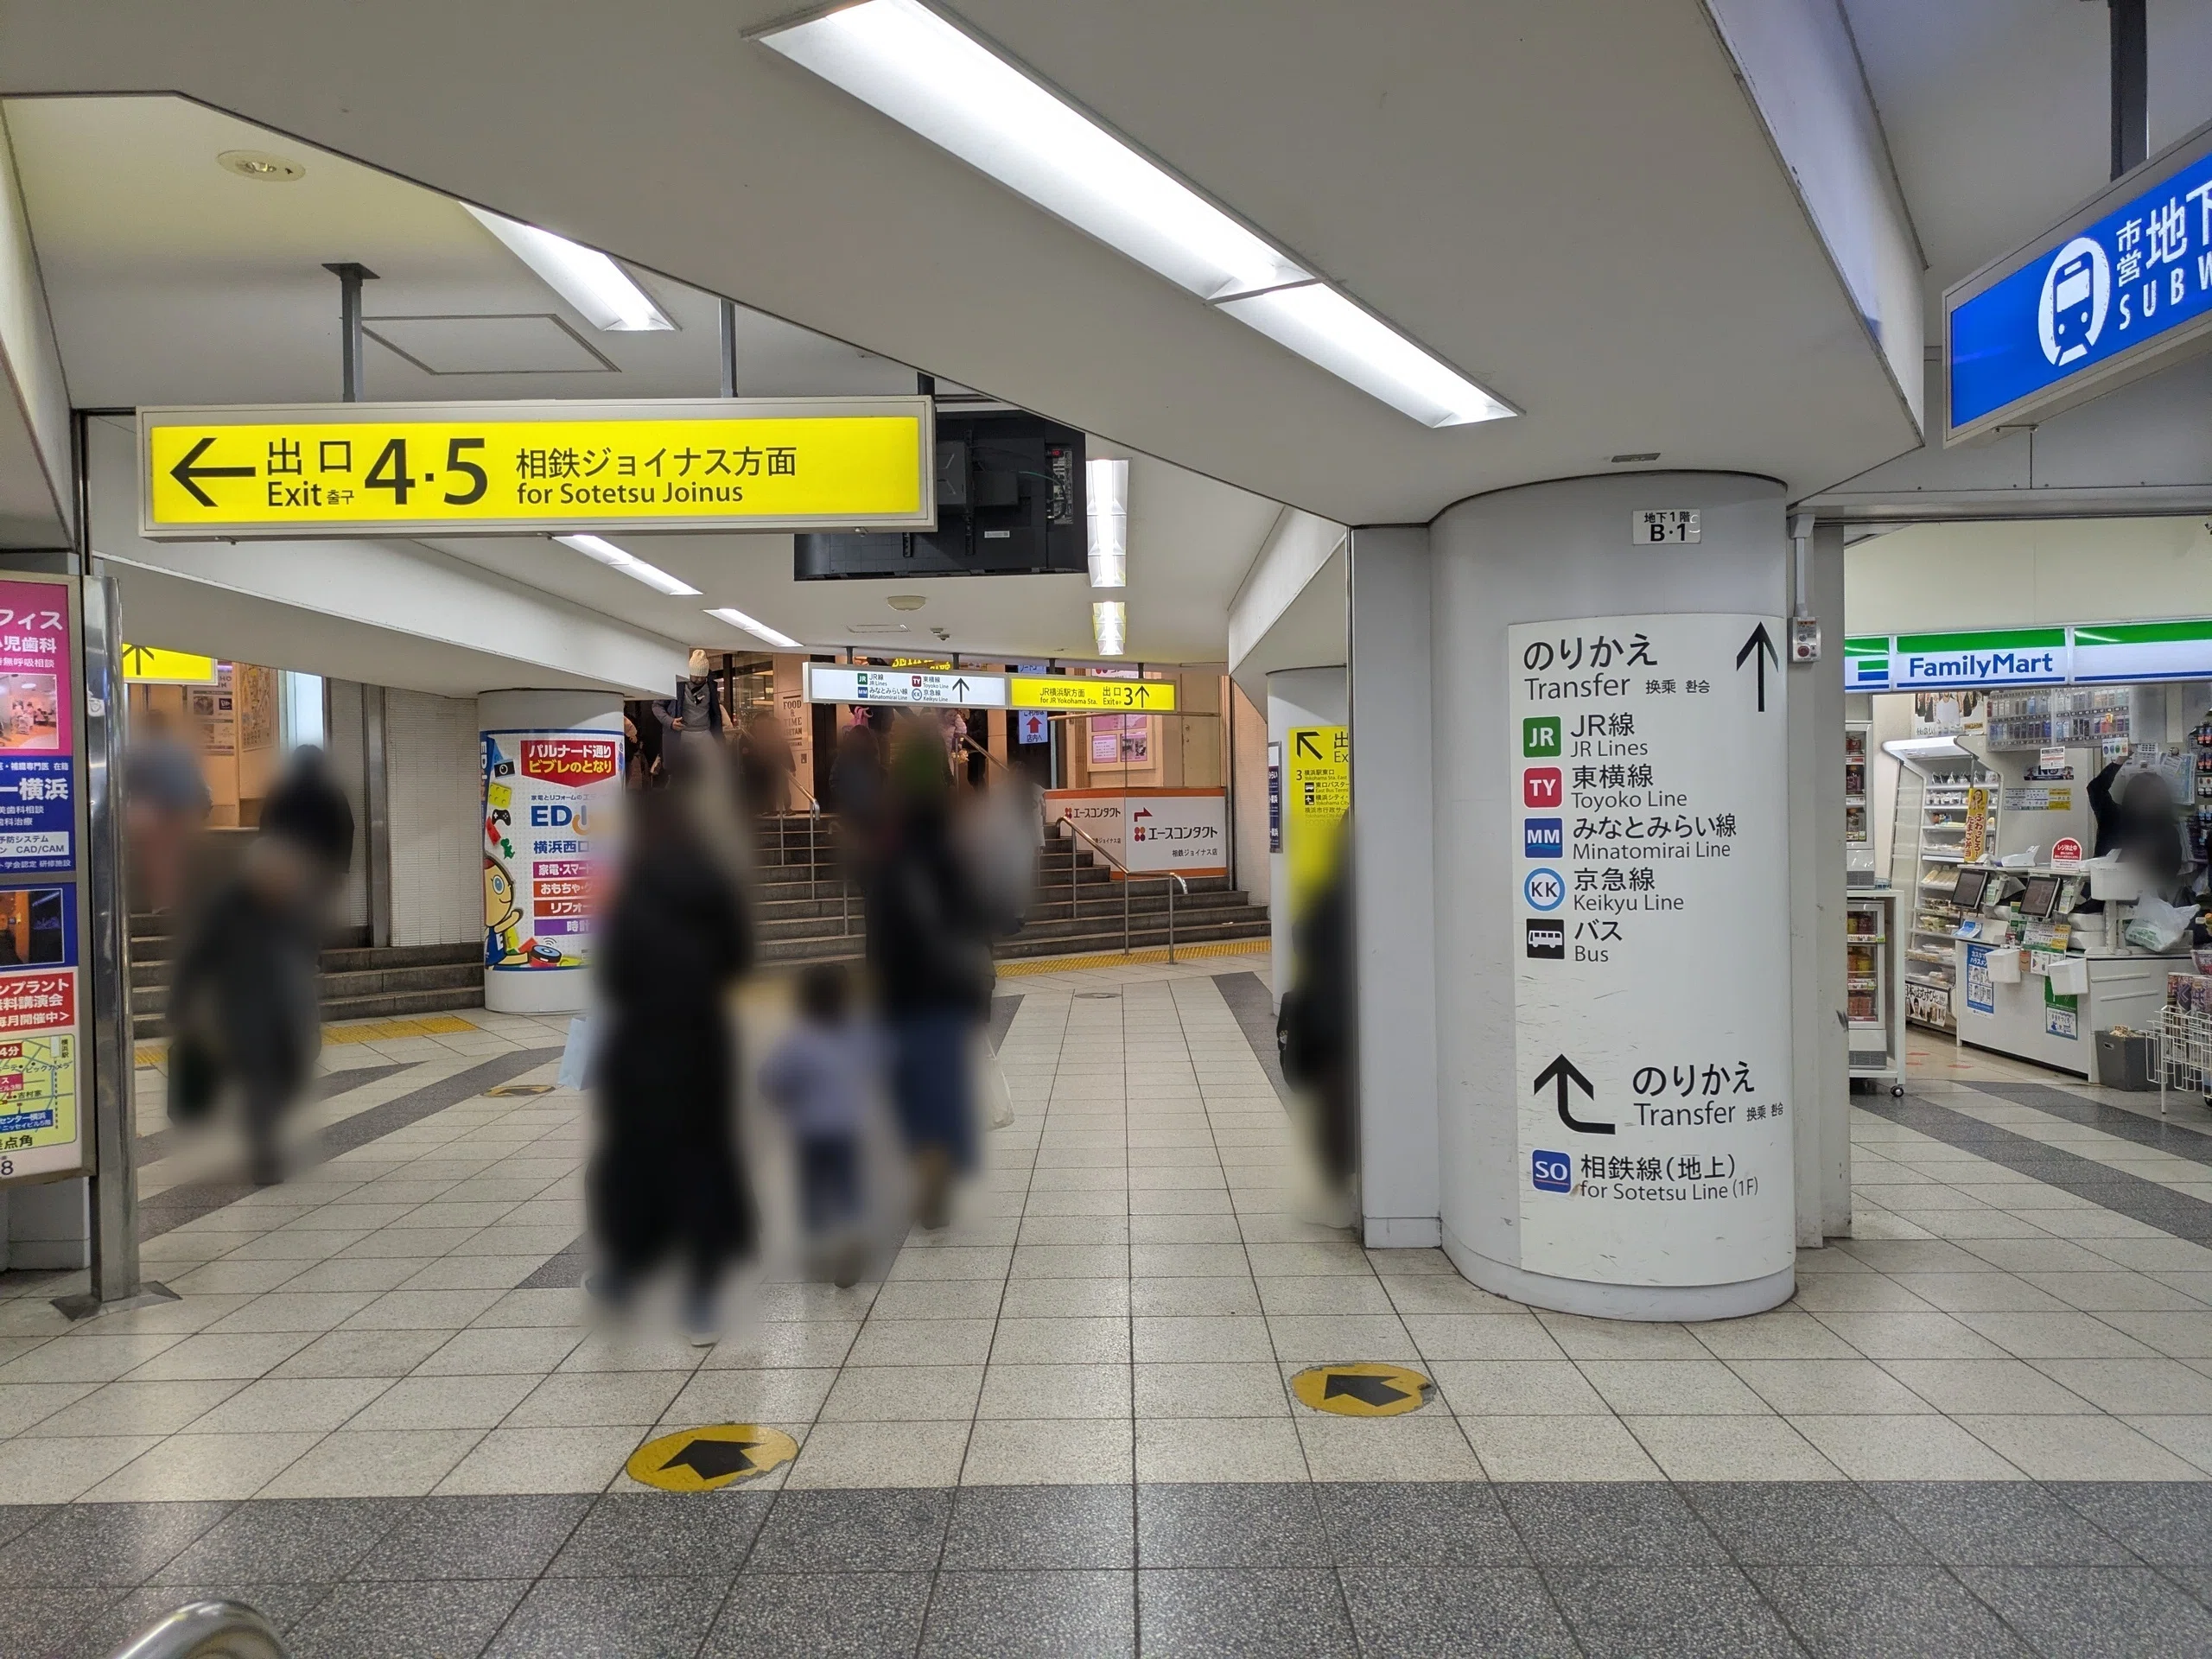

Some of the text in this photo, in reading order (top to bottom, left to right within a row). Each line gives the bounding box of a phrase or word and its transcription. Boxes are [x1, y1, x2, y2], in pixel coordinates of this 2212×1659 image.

[2116, 218, 2142, 288] 市営
[267, 438, 352, 475] 出口
[516, 447, 797, 479] 相鉄ジョイナス方面
[268, 481, 354, 506] Exit 출구
[517, 481, 743, 504] for Sotetsu Joinus
[0, 609, 63, 630] フィス
[0, 635, 56, 654] 児歯科
[1523, 633, 1658, 671] のりかえ
[1910, 652, 2053, 678] FamilyMart
[1040, 688, 1084, 697] JR横浜駅方面
[1103, 686, 1122, 696] 出口
[1124, 688, 1133, 706] 3
[1524, 673, 1630, 701] Transfer
[1685, 679, 1711, 694] 환승
[784, 700, 802, 709] FOOD
[1570, 712, 1636, 738] JR線
[1529, 728, 1554, 747] JR
[529, 745, 612, 758] パルナード通り
[1571, 741, 1649, 757] JR Lines
[529, 760, 612, 773] ビブレのとなり
[1296, 770, 1302, 780] 3
[1572, 764, 1654, 790] 東横線
[1529, 779, 1556, 797] TY
[1571, 791, 1688, 812] Toyoko Line
[1074, 807, 1121, 818] エースコンタクト
[1148, 826, 1217, 841] エースコンタクト
[1573, 813, 1737, 840] みなとみらい線
[1527, 830, 1560, 844] MM
[16, 845, 65, 854] CAD/CAM
[1172, 849, 1217, 857] 相鉄ジョイナス店
[1573, 841, 1731, 860] Minatomirai Line
[1531, 882, 1558, 898] KK
[1573, 868, 1656, 892] 京急線
[1573, 893, 1684, 916] Keikyu Line
[1574, 919, 1623, 942] バス
[1574, 945, 1609, 963] Bus
[1632, 1060, 1755, 1097] のりかえ
[1633, 1100, 1736, 1126] Transfer
[1770, 1102, 1783, 1117] 환승
[1535, 1161, 1568, 1181] SO
[1580, 1176, 1758, 1201] for Sotetsu Line (1F)
